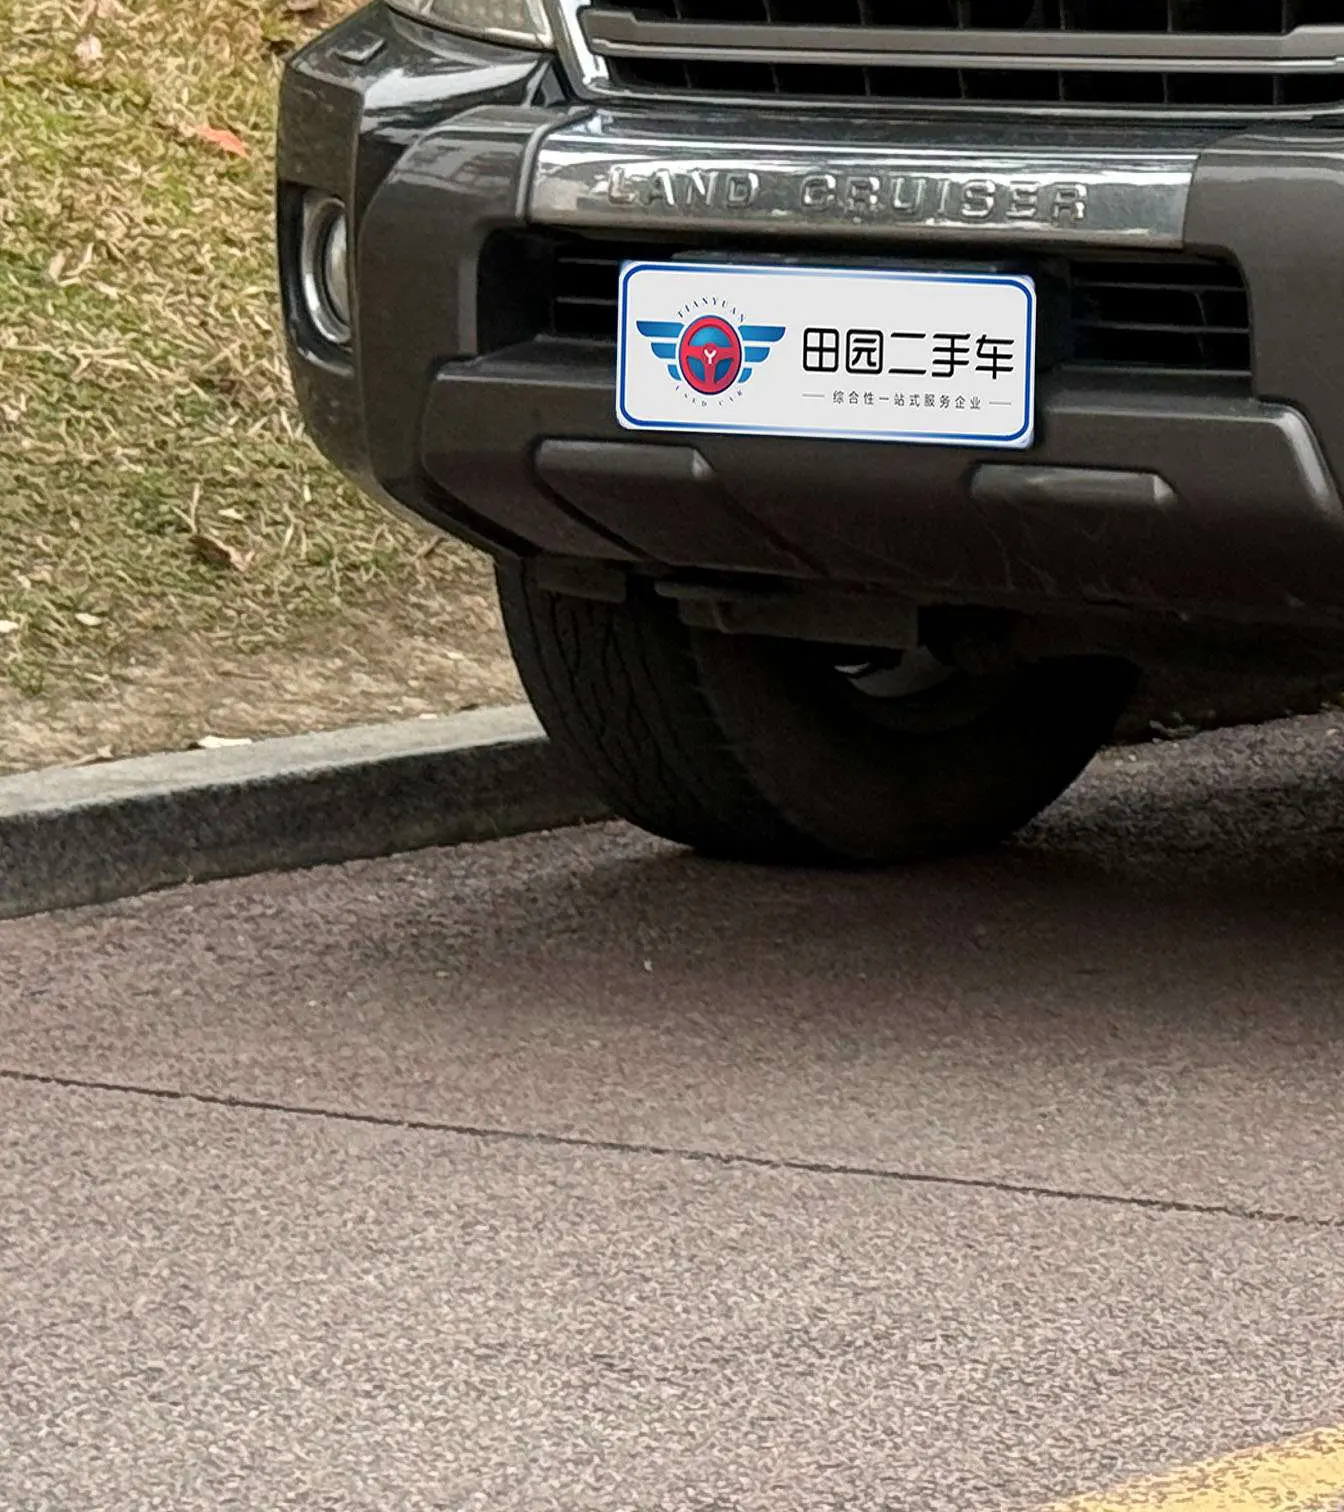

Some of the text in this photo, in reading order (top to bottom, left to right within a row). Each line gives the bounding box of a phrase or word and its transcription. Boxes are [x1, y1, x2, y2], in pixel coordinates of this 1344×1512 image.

[605, 163, 1088, 223] LAND CRUISER
[802, 326, 1015, 380] 田园二手车
[832, 389, 981, 410] 综合性一站式服务企业
